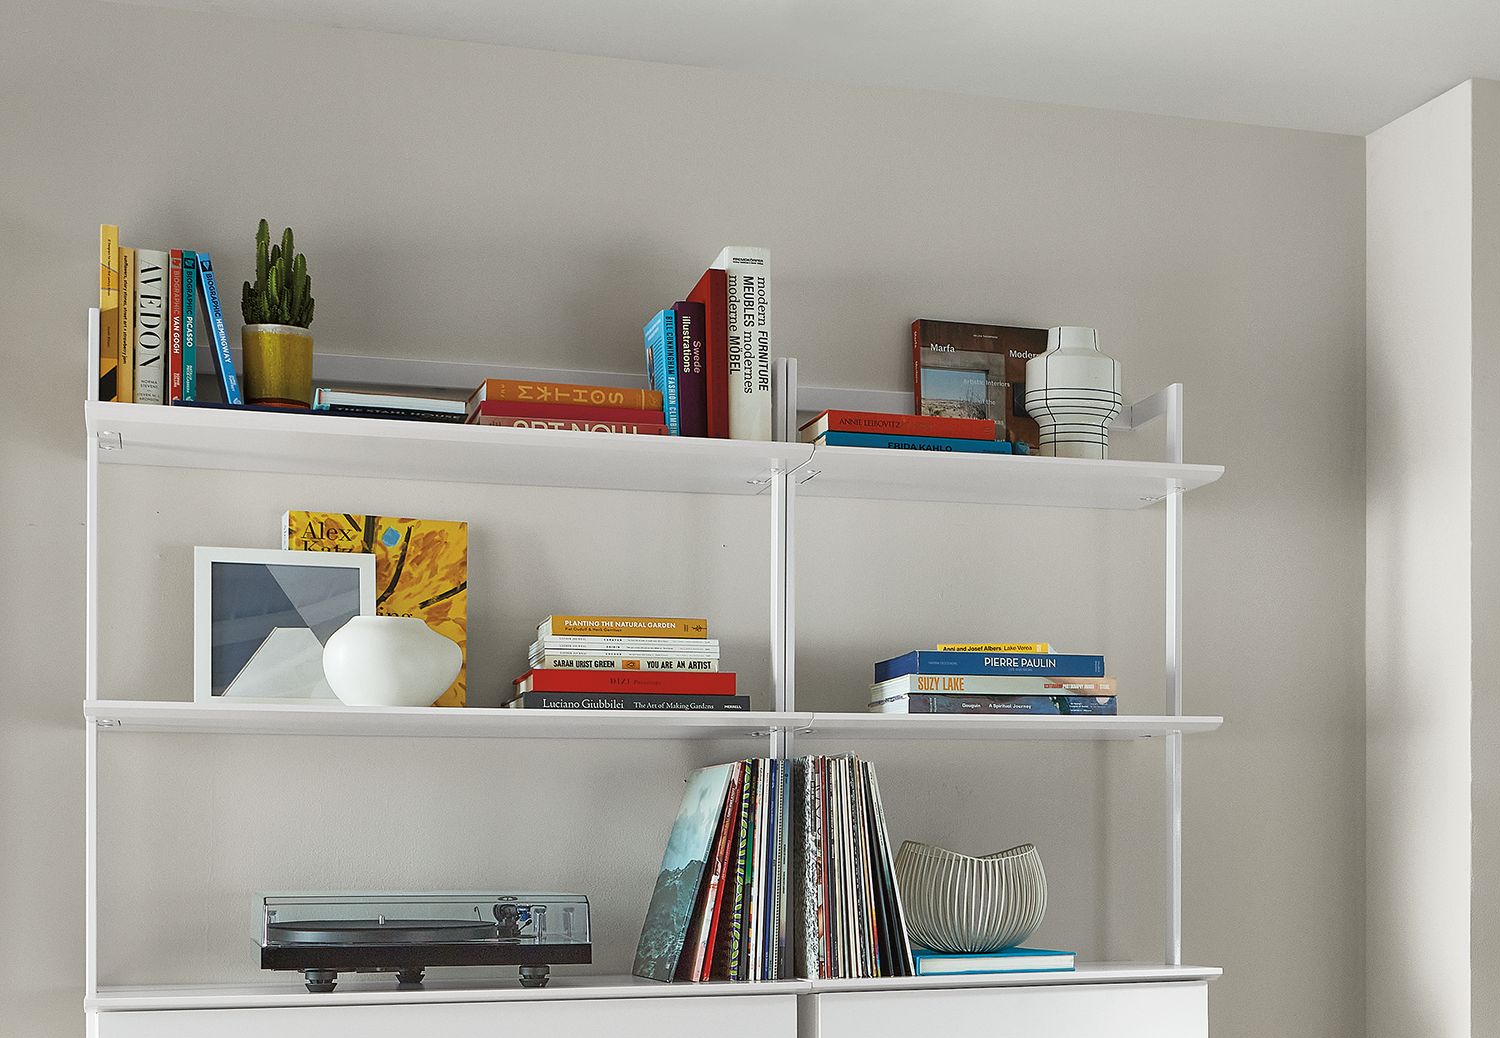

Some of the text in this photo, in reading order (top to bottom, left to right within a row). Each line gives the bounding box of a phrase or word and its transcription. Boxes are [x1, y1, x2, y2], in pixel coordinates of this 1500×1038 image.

[139, 259, 163, 368] AVEDON
[205, 273, 222, 318] BIOGRAPHIC
[215, 318, 232, 363] HEMINGWAY
[728, 275, 743, 375] moderne MÖBEL
[682, 316, 691, 373] illustrations
[743, 275, 755, 394] MEUBLES modernes
[757, 276, 769, 391] modern FURNITURE
[692, 340, 702, 374] Swede
[930, 343, 956, 353] Marfa
[665, 316, 678, 434] BILL CUNNINGHAM FASHION CLIMBIN
[839, 417, 863, 427] ANNIE
[887, 442, 953, 452] FRIDA KAHLO
[301, 521, 353, 542] Alex
[553, 659, 711, 670] SARAH URIST GREEN YOU ARE AN ARTIST
[984, 657, 1056, 669] PIERRE PAULIN
[917, 676, 965, 691] SUZY LAKE
[543, 698, 580, 709] Luciano
[581, 699, 624, 709] Giubbilei
[633, 701, 646, 709] The
[666, 702, 689, 711] Making
